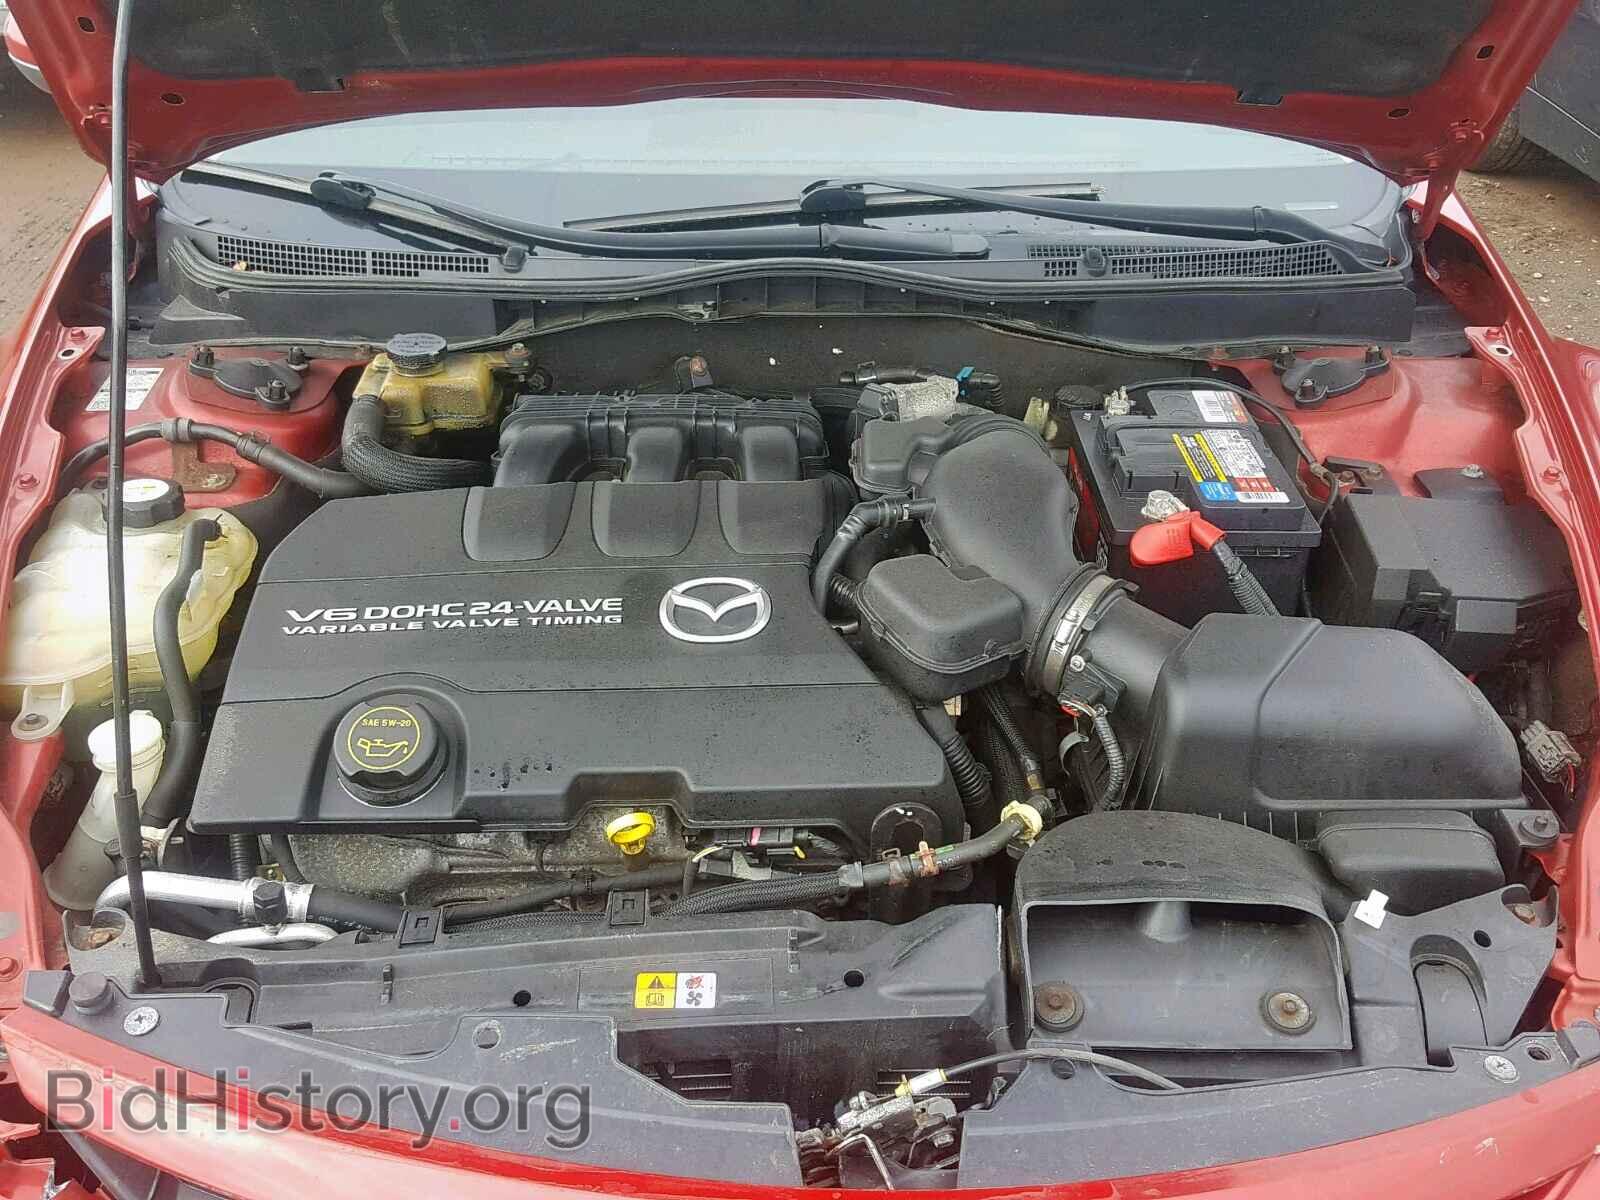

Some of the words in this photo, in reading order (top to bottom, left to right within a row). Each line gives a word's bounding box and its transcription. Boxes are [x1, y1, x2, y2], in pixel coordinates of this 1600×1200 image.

[286, 607, 357, 623] V6
[363, 602, 468, 620] DOHC
[469, 597, 624, 616] 24-VALVE
[282, 621, 425, 636] VARIABLE
[432, 617, 520, 629] VALVE
[527, 614, 624, 626] TIMING
[361, 718, 380, 728] SAE
[381, 718, 412, 728] 5W-20
